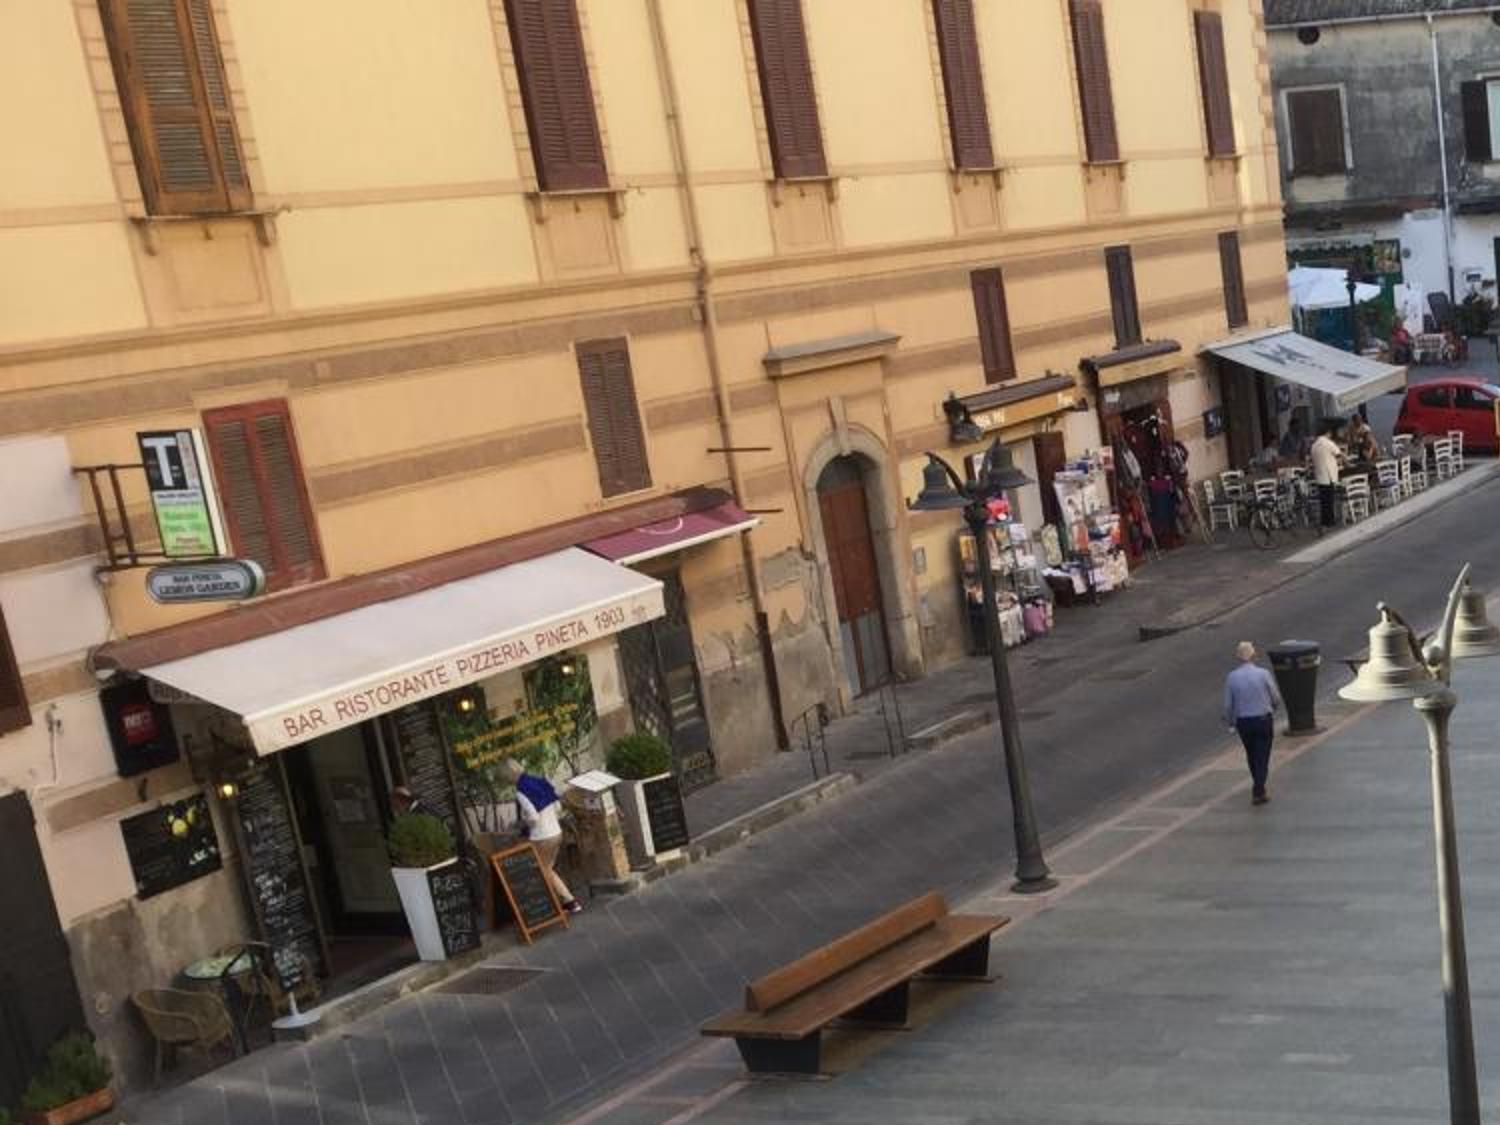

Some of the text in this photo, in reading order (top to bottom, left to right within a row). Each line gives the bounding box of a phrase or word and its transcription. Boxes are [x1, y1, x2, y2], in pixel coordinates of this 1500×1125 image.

[283, 607, 626, 738] BAR RISTORANTE PIZZERIA PINETA 1903
